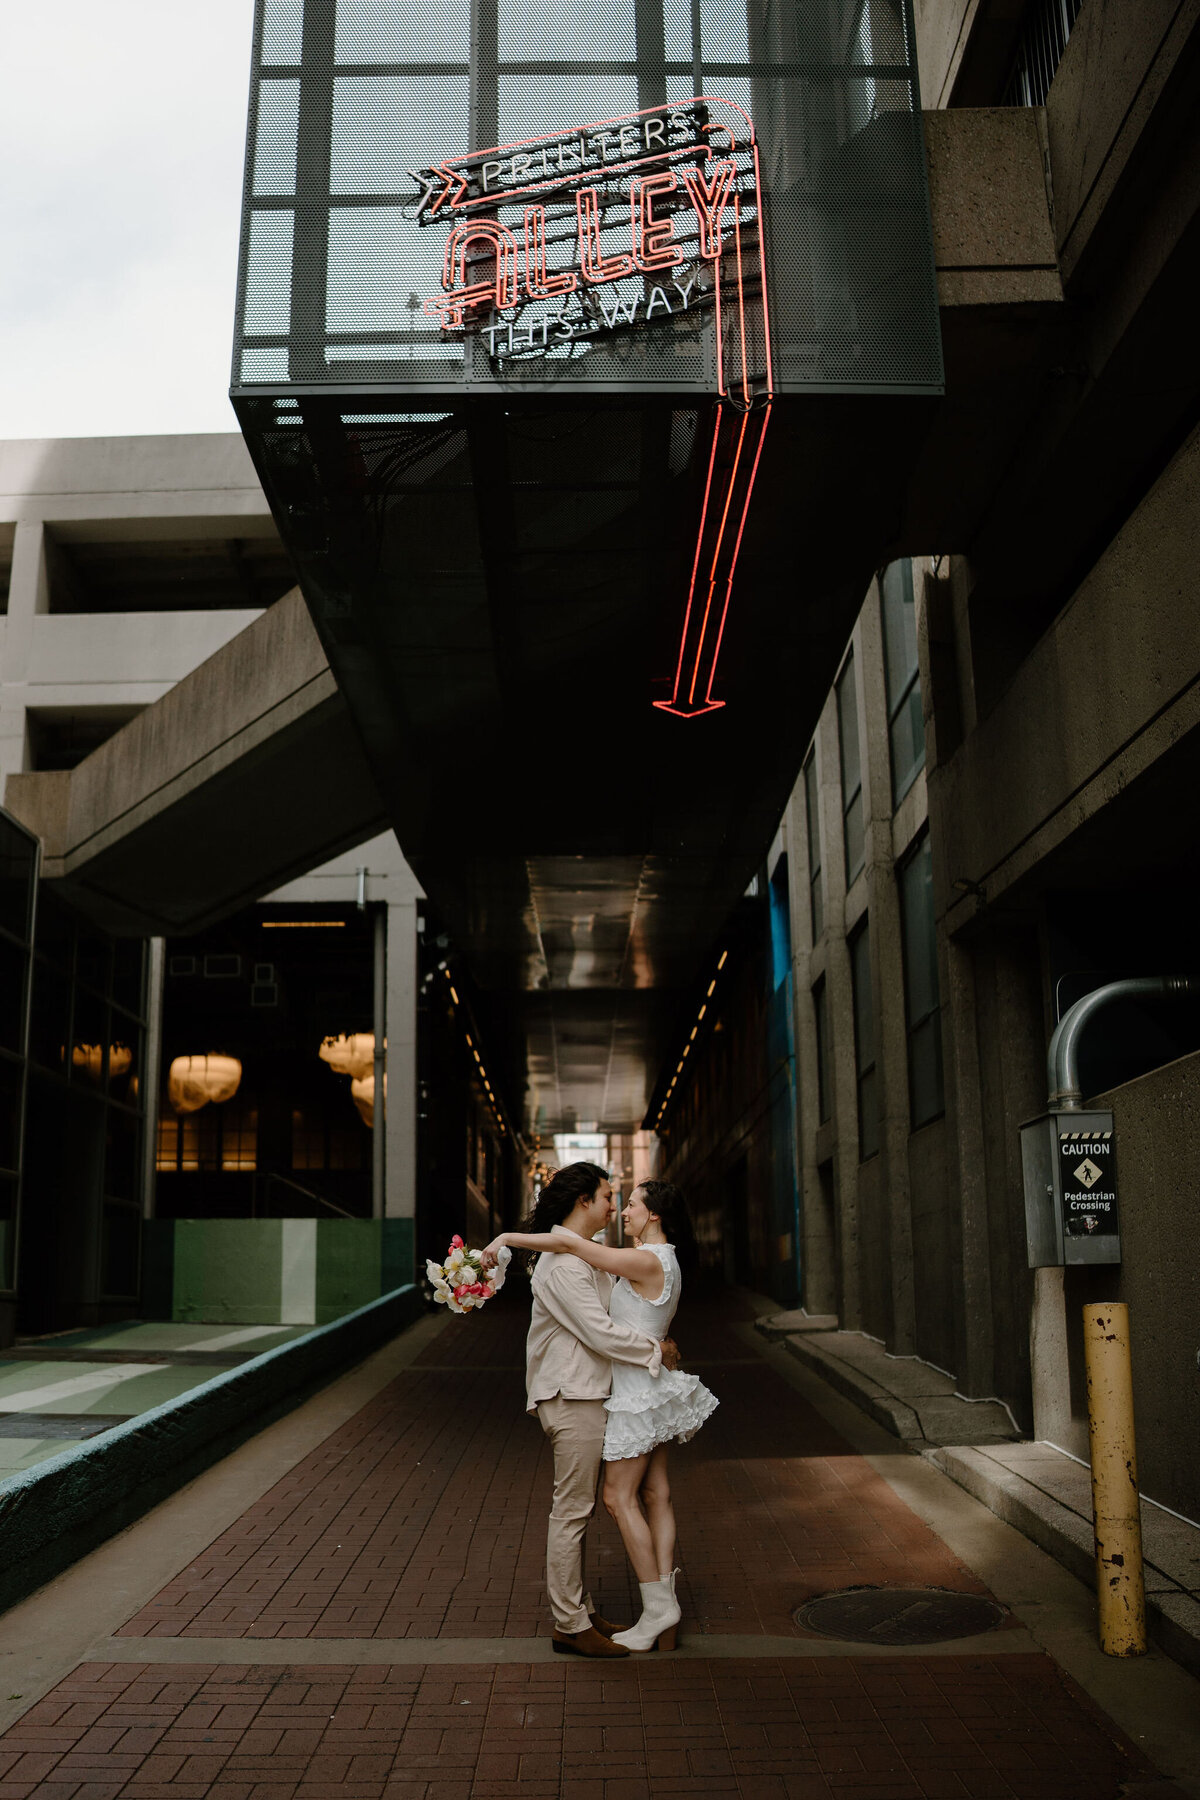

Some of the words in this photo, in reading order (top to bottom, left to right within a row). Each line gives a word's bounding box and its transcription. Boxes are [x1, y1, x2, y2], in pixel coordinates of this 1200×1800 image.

[482, 112, 690, 192] PRINTERS
[424, 160, 737, 330] ALLEY
[481, 309, 574, 356] THIS
[601, 280, 694, 329] WAY
[1062, 1143, 1110, 1155] CAUTION
[1064, 1192, 1115, 1201] Pedestrian
[1070, 1201, 1111, 1211] Crossing
